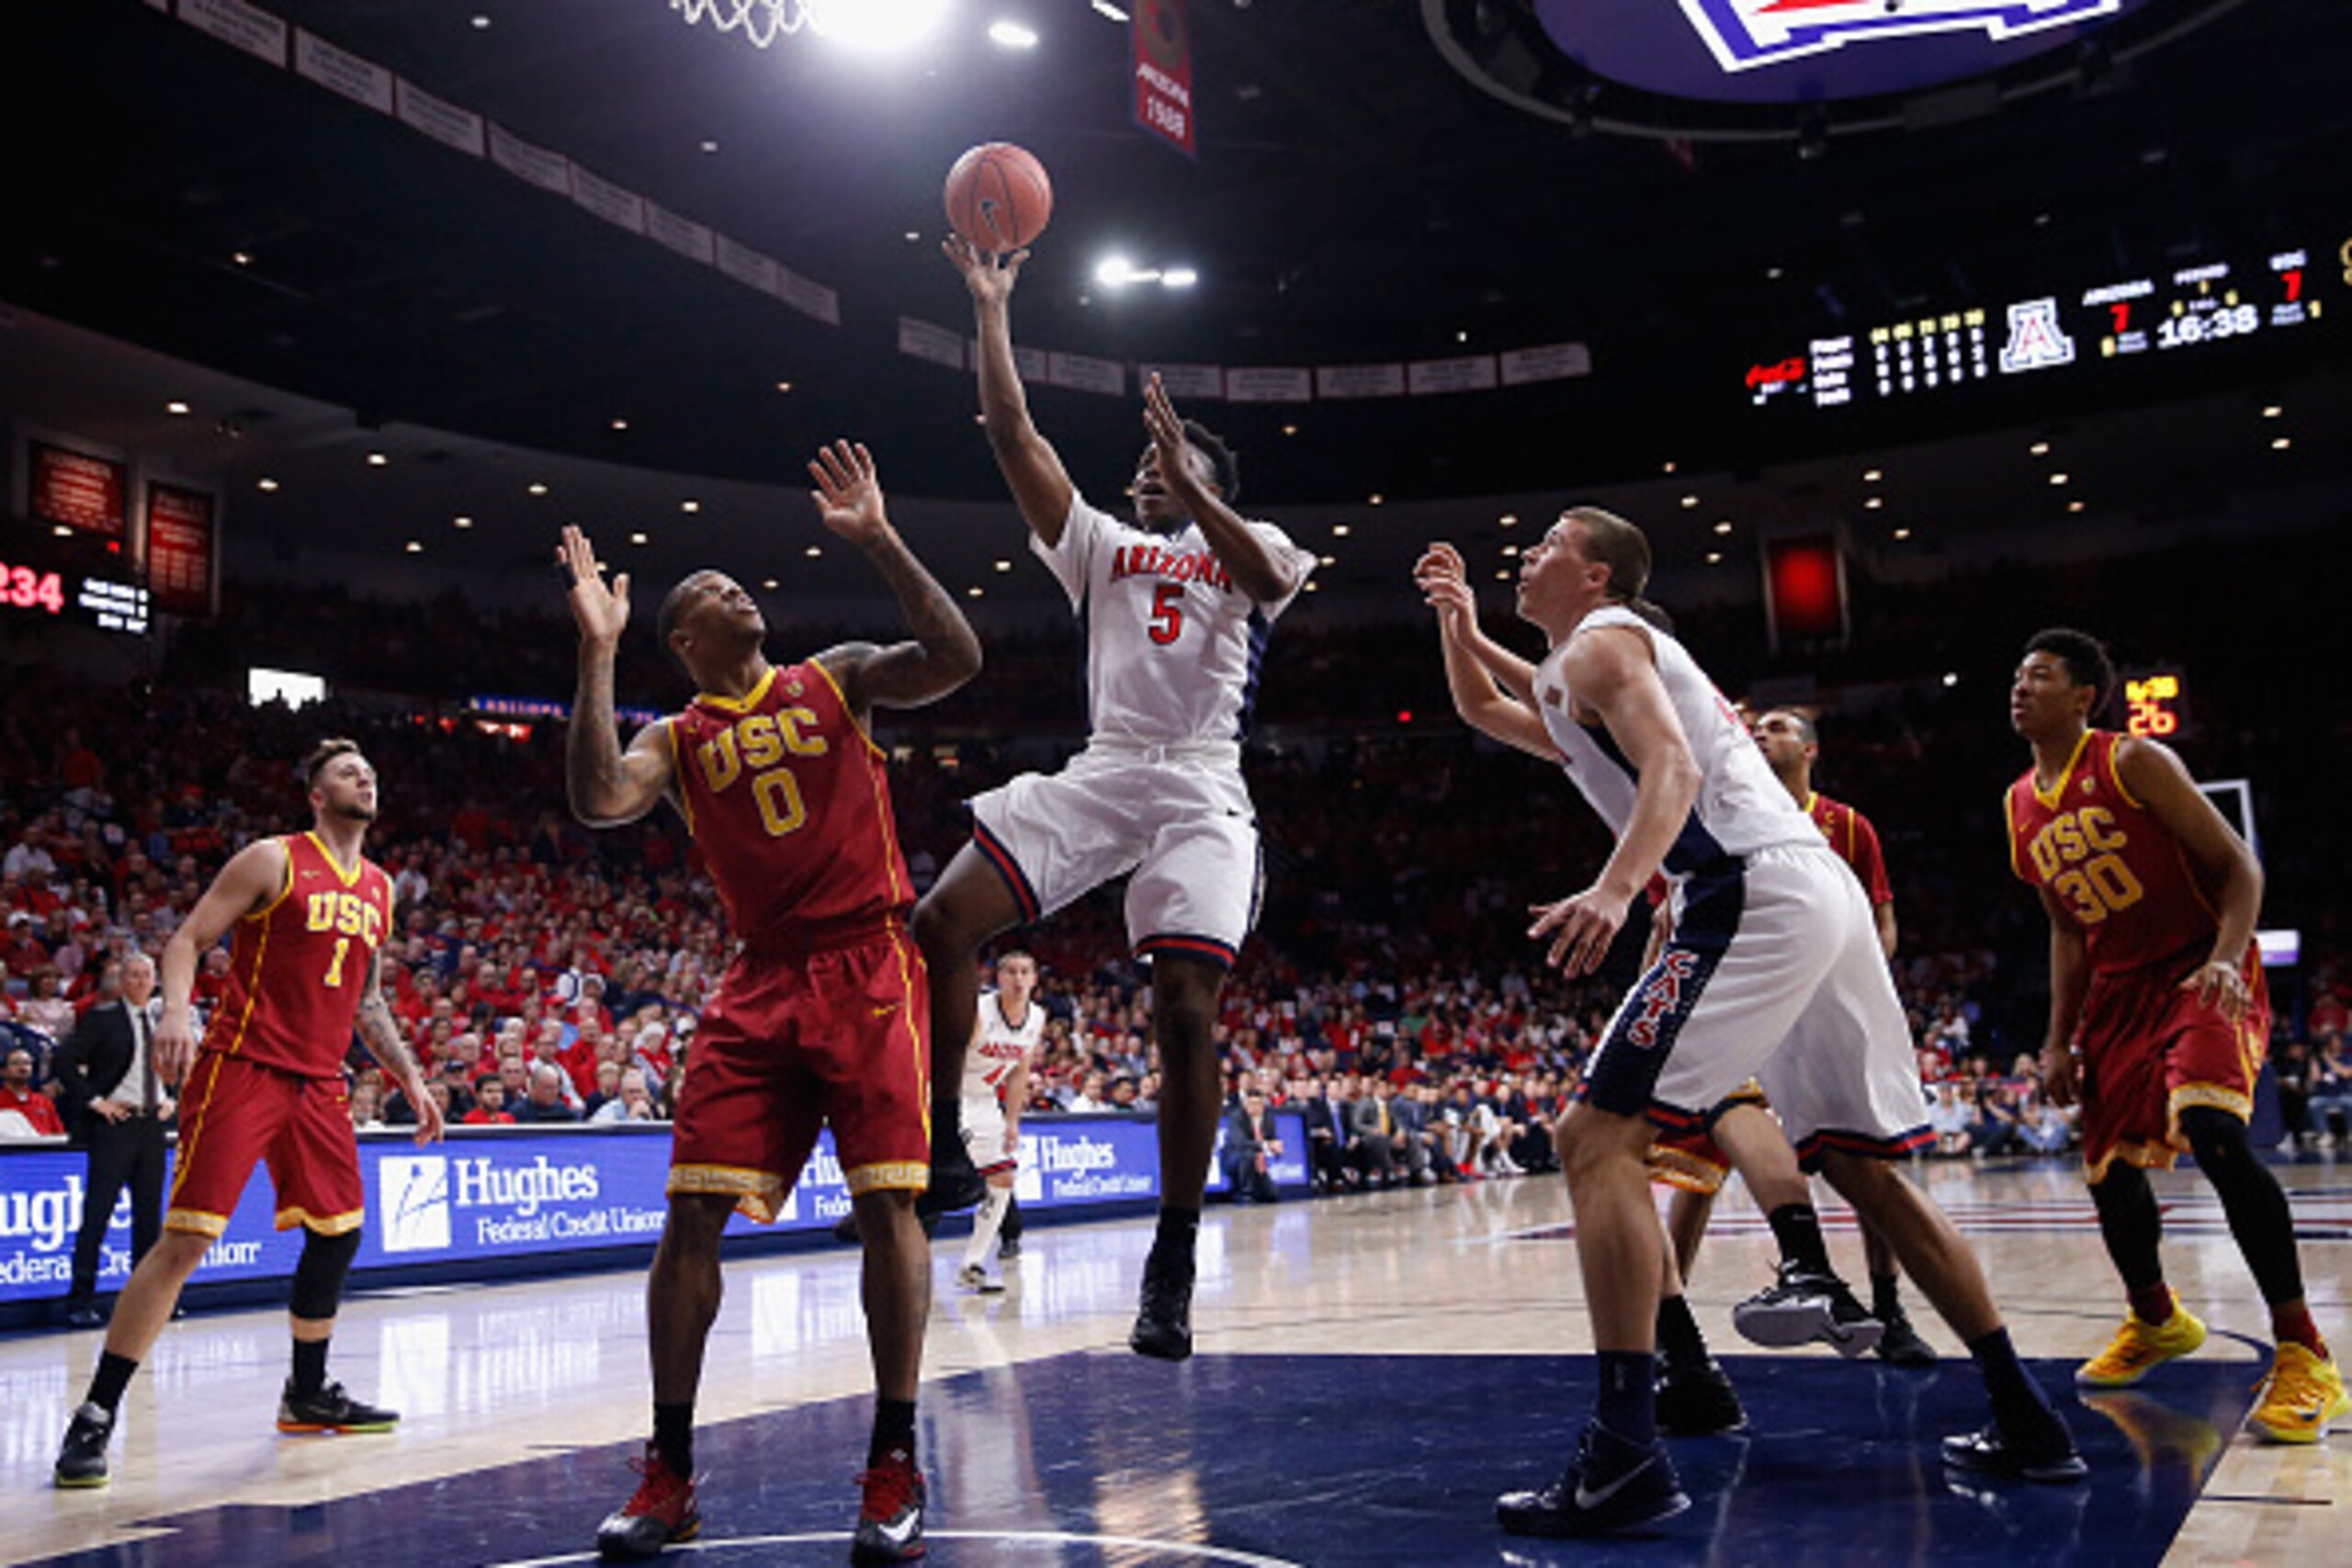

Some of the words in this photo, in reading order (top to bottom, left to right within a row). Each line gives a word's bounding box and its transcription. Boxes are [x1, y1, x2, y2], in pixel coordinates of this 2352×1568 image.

[1109, 544, 1233, 594] ARIZONA
[1148, 581, 1185, 646] 5
[696, 705, 828, 794] USC
[752, 767, 807, 836] 0
[2028, 806, 2129, 882] USC
[2054, 852, 2144, 924] 30
[306, 890, 382, 950] USC
[323, 937, 350, 987] 1
[1626, 949, 1700, 1048] CATS
[454, 1156, 599, 1216] Hughes
[1040, 1134, 1116, 1179] Hughes
[476, 1213, 550, 1244] Federal
[552, 1210, 610, 1237] Credit
